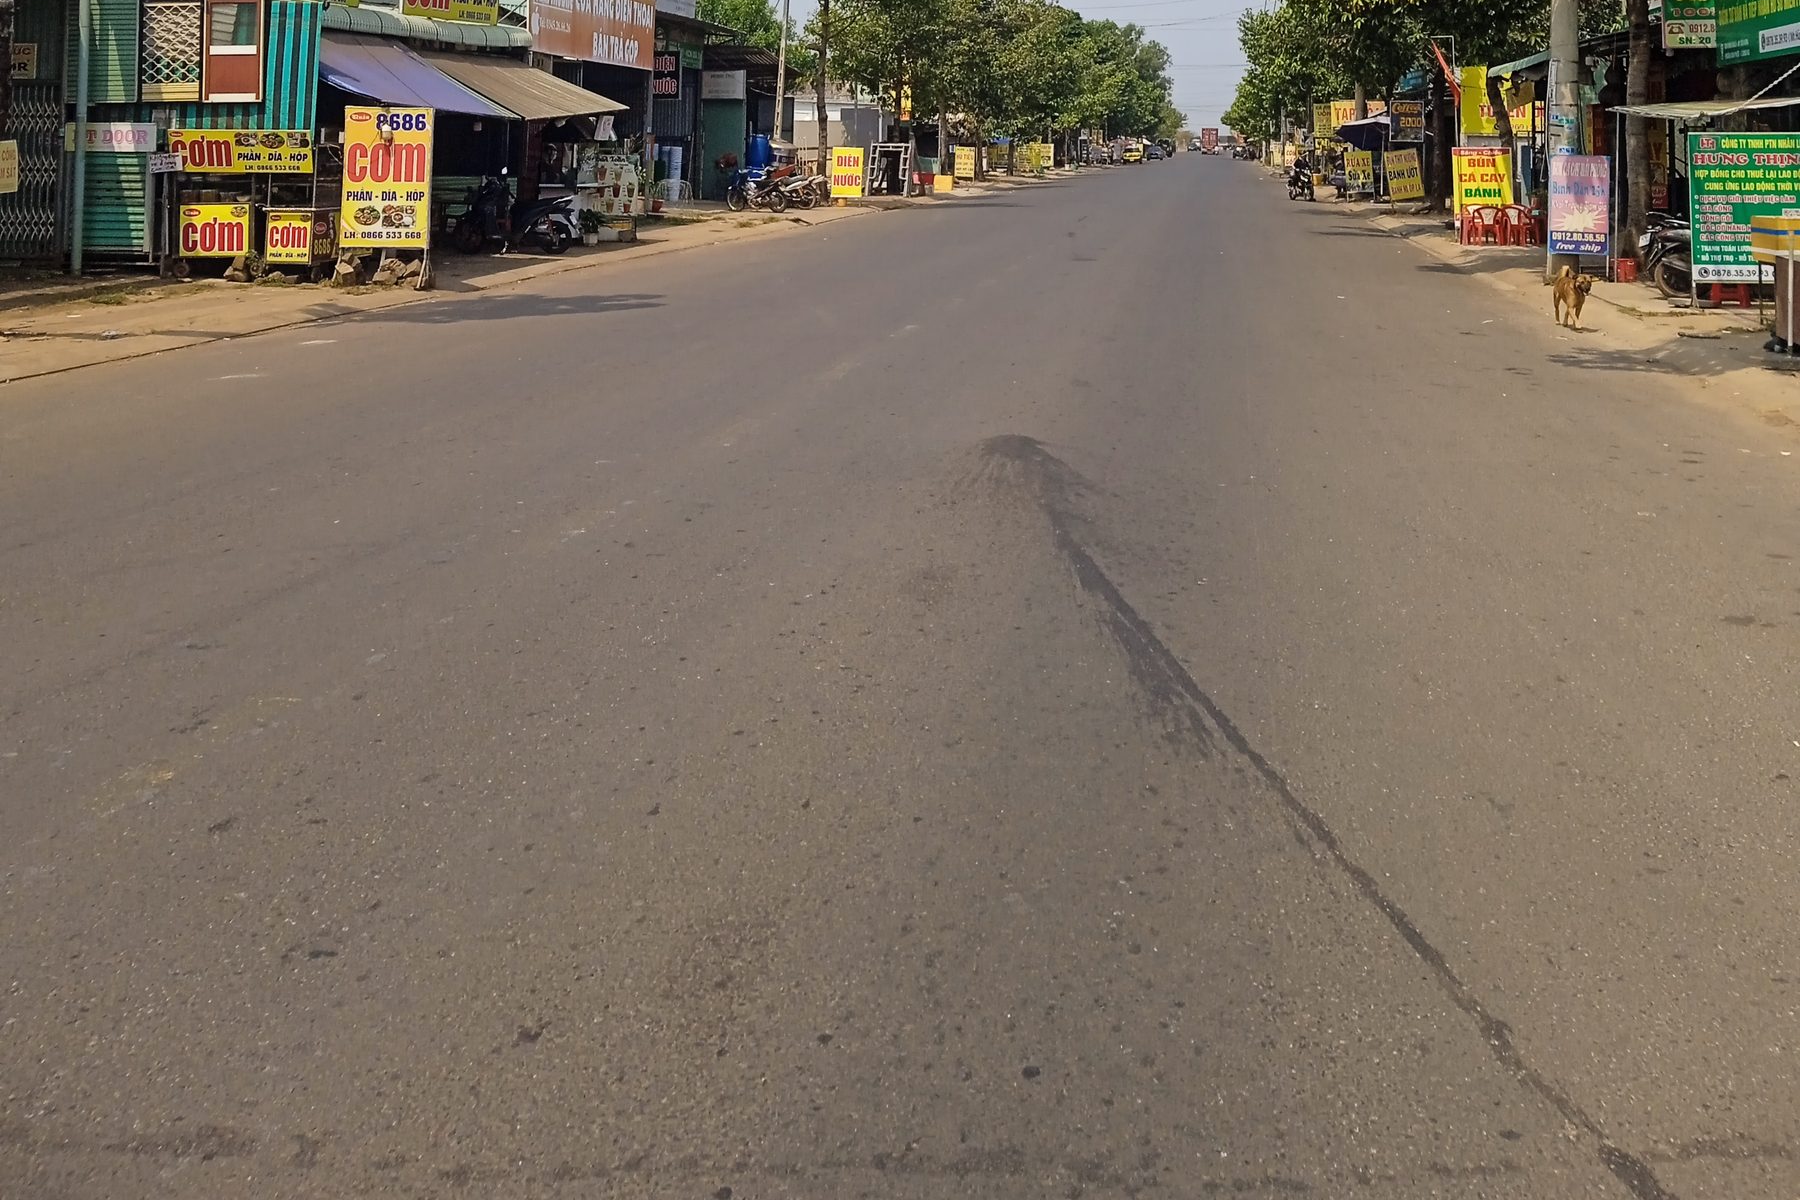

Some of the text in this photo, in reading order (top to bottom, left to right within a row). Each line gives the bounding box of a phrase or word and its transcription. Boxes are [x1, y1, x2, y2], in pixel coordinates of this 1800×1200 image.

[633, 1, 654, 34] THOẠI
[593, 26, 639, 64] BÁN TRẢ GÓP
[376, 113, 426, 131] 8686
[102, 129, 148, 145] DOOR
[1739, 138, 1747, 148] TY
[1468, 156, 1496, 168] BÚN
[1693, 152, 1800, 168] HƯNG THỊN
[1459, 172, 1477, 183] CÁ
[1731, 169, 1745, 178] CHO
[1778, 169, 1791, 178] LAO
[833, 174, 861, 187] NƯỚC
[1704, 182, 1724, 191] CUNG
[1741, 182, 1755, 191] LAO
[1464, 186, 1501, 198] BÁNH
[361, 231, 383, 239] 0866
[386, 231, 402, 239] 533
[405, 231, 422, 239] 668
[1556, 242, 1602, 253] free ship
[1711, 269, 1769, 278] 0878.35.39.3
